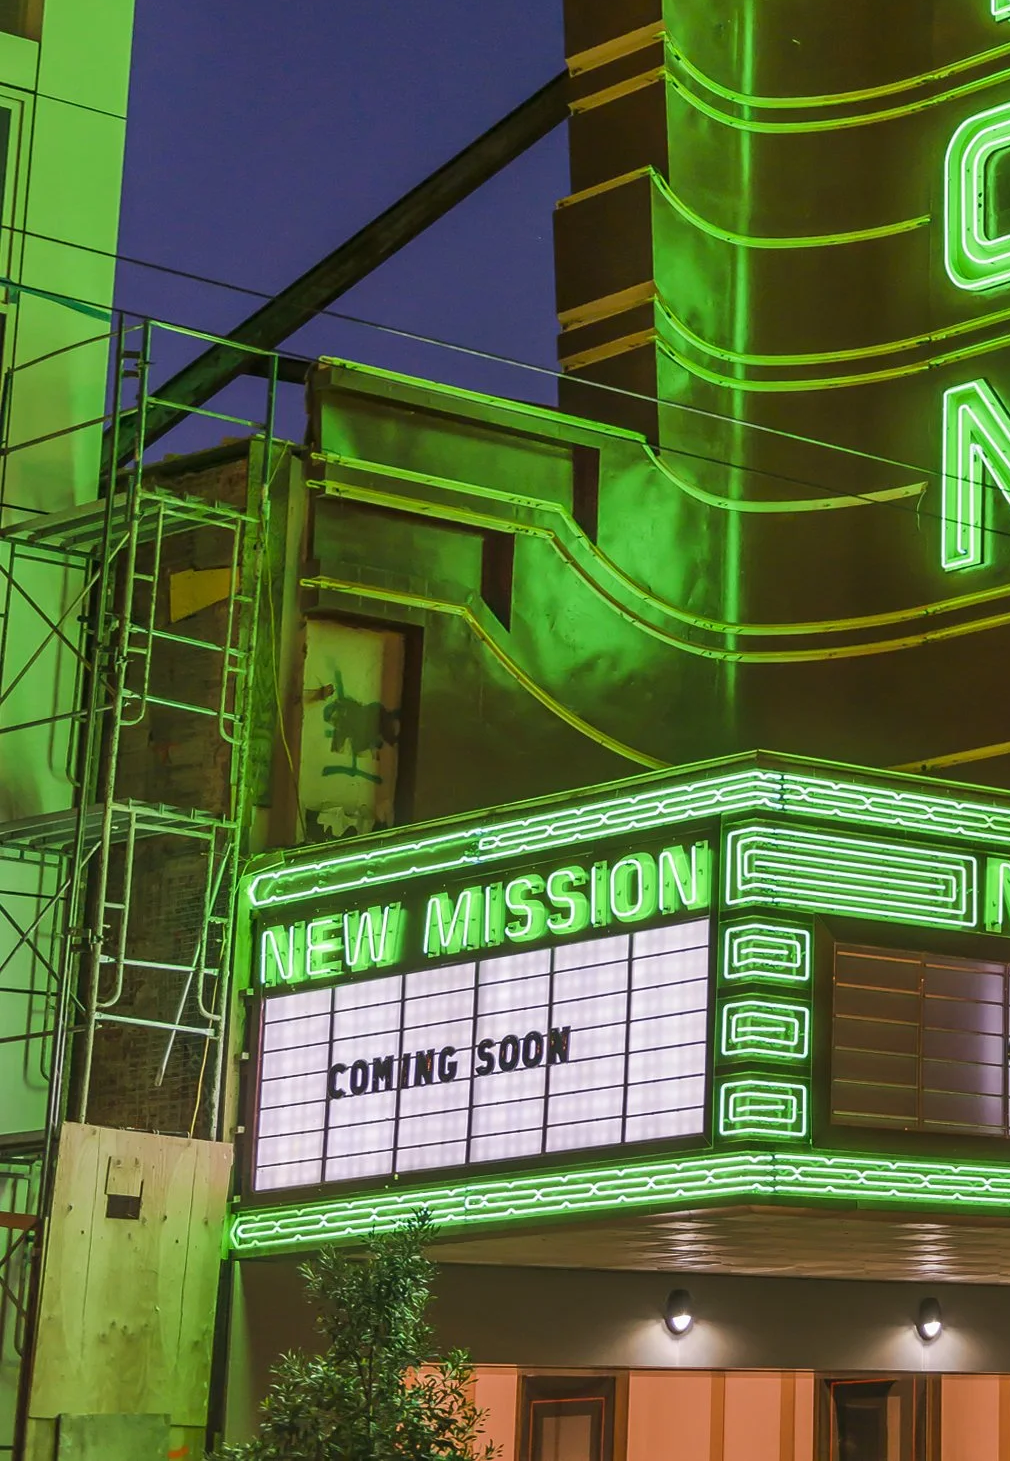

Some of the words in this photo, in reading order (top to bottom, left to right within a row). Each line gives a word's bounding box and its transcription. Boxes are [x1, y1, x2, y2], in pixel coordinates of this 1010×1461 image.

[260, 900, 402, 987] NEW
[423, 839, 712, 959] MISSION
[327, 1045, 459, 1100] COMING
[474, 1025, 572, 1077] SOON
